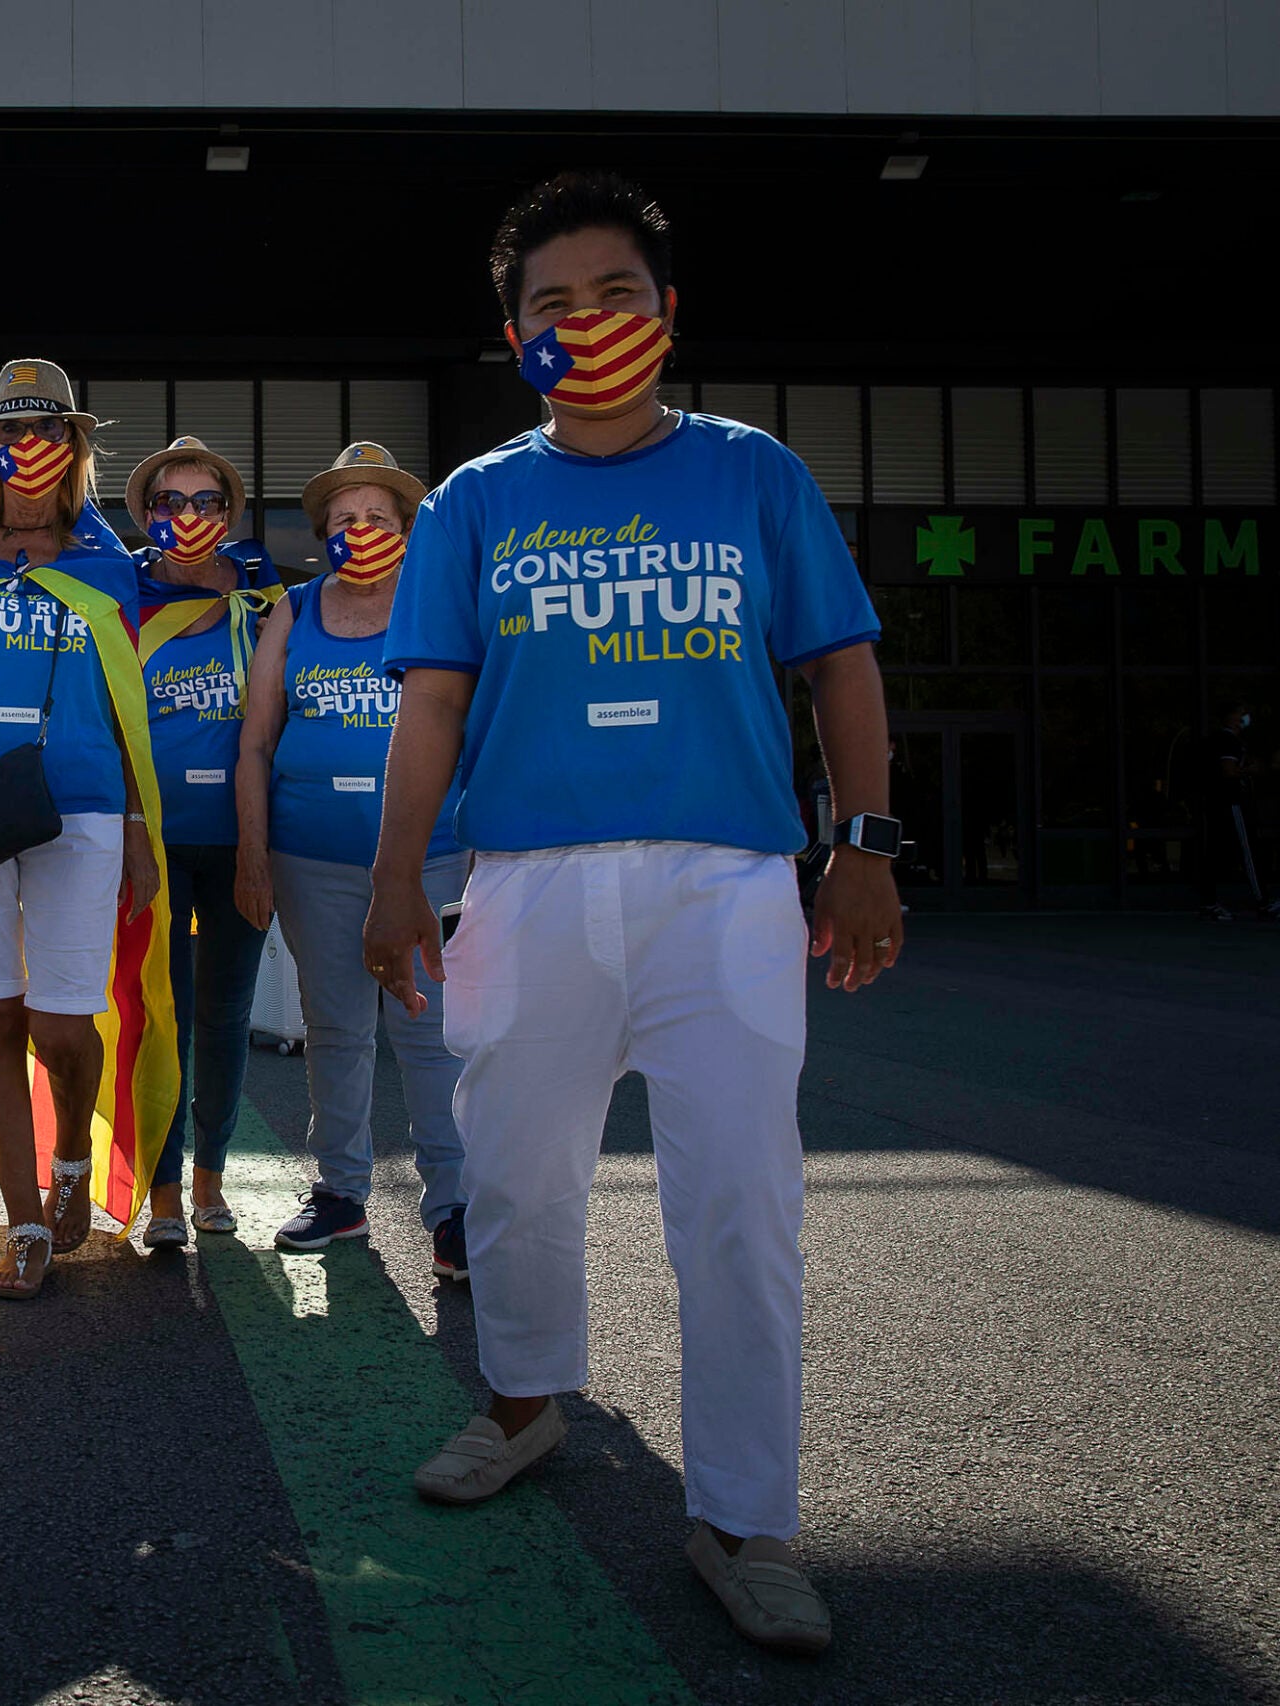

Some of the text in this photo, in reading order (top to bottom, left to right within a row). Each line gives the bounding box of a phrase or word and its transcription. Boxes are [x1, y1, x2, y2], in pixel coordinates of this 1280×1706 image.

[492, 513, 660, 562] el deure de
[1018, 518, 1261, 577] FARM
[491, 541, 744, 594] CONSTRUIR
[499, 575, 742, 637] un FUTUR
[5, 633, 87, 655] MILLOR
[588, 627, 743, 664] MILLOR
[151, 657, 226, 686] el deure de
[295, 661, 374, 684] el deure de
[153, 672, 246, 699] CONSTRU
[295, 677, 403, 700] CONSTRUI
[175, 687, 240, 712] FUTU
[304, 692, 402, 718] un FUTU
[1, 709, 36, 719] assemblea
[197, 707, 247, 722] MILLO
[343, 713, 398, 729] MILLO
[597, 706, 652, 720] assemblea
[338, 780, 371, 788] assemblea
